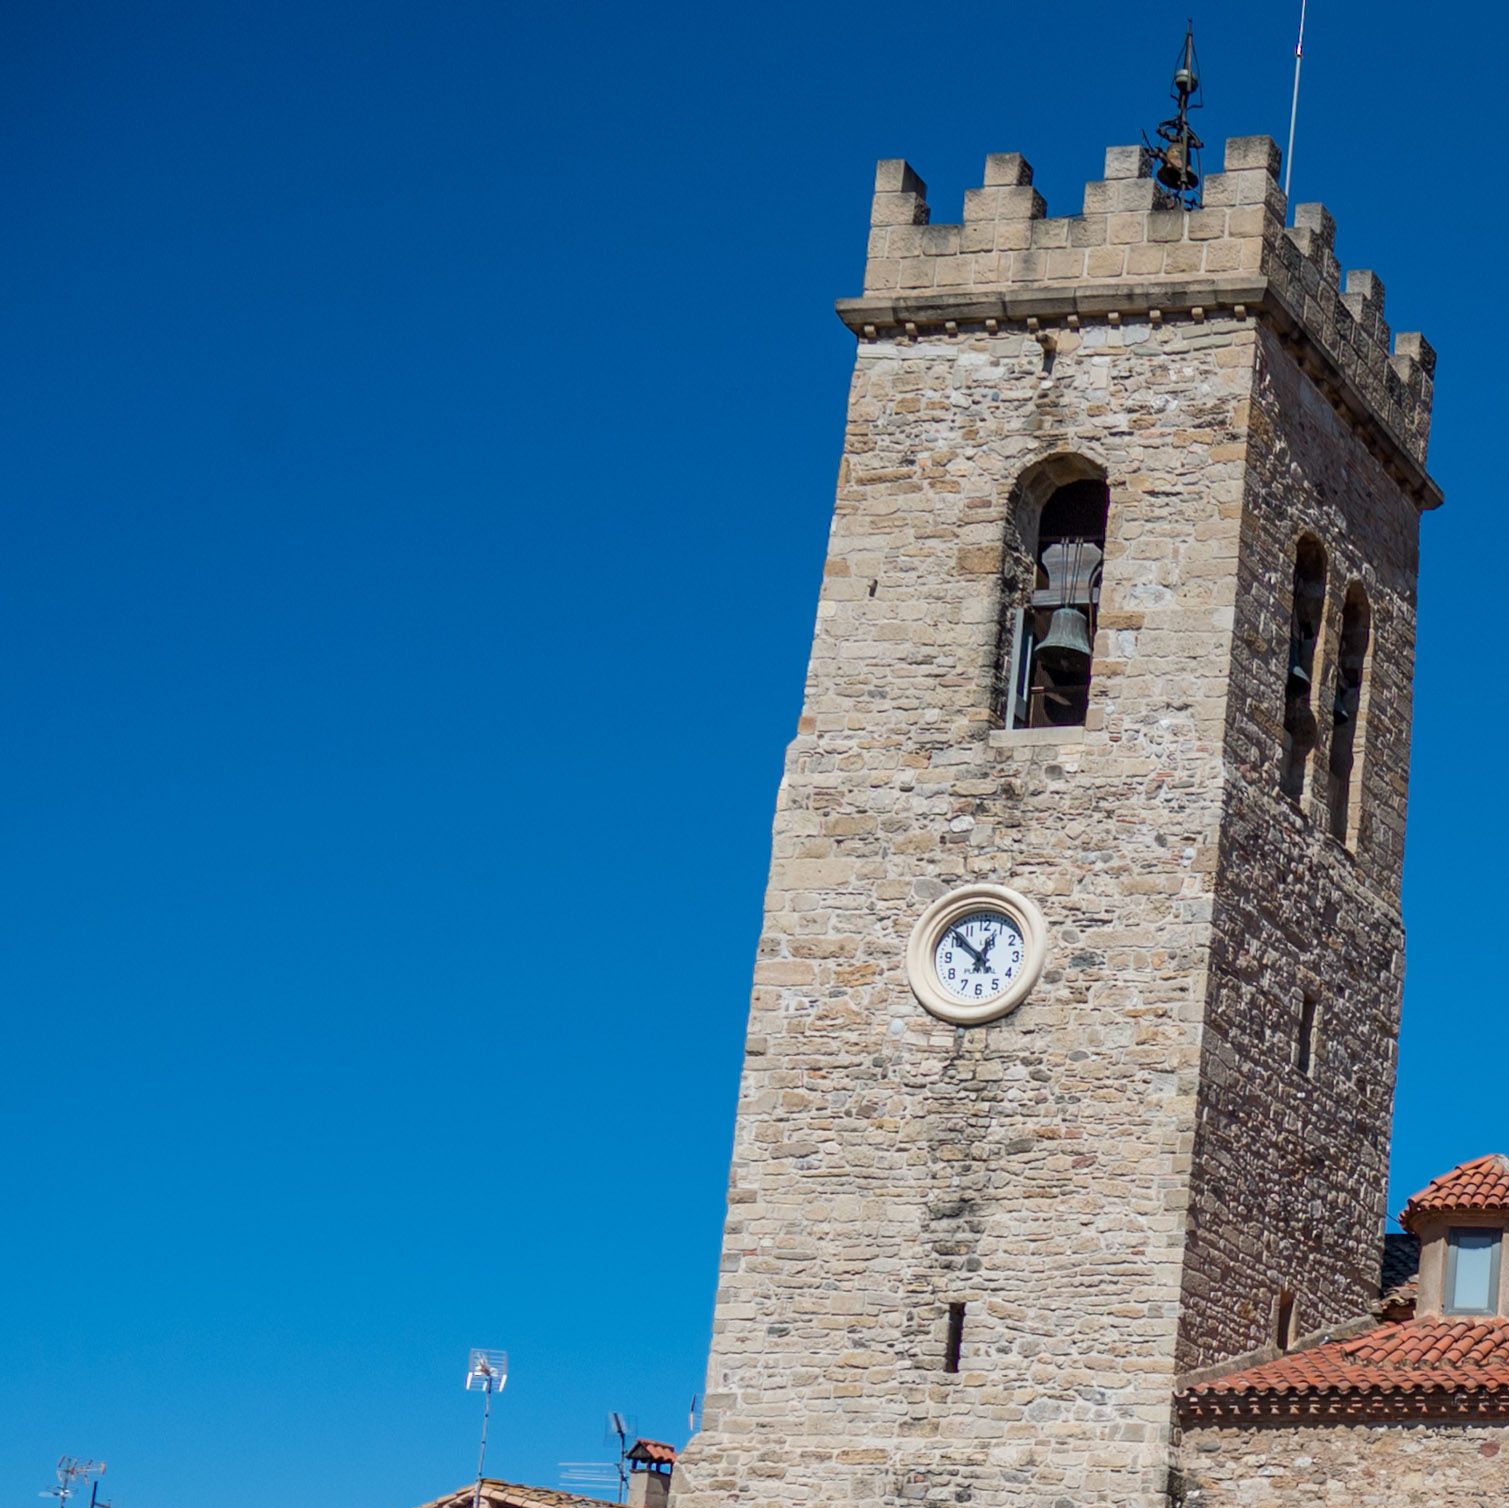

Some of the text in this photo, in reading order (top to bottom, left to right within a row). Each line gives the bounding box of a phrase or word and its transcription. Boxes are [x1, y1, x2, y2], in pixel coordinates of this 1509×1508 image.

[966, 925, 973, 937] 11
[980, 919, 991, 931] 12
[1008, 935, 1016, 946] 2
[944, 952, 952, 963] 9
[1012, 951, 1020, 963] 3
[948, 968, 955, 980] 8
[1005, 966, 1012, 978] 4
[961, 979, 968, 991] 7
[975, 984, 982, 995] 6
[991, 979, 999, 990] 5
